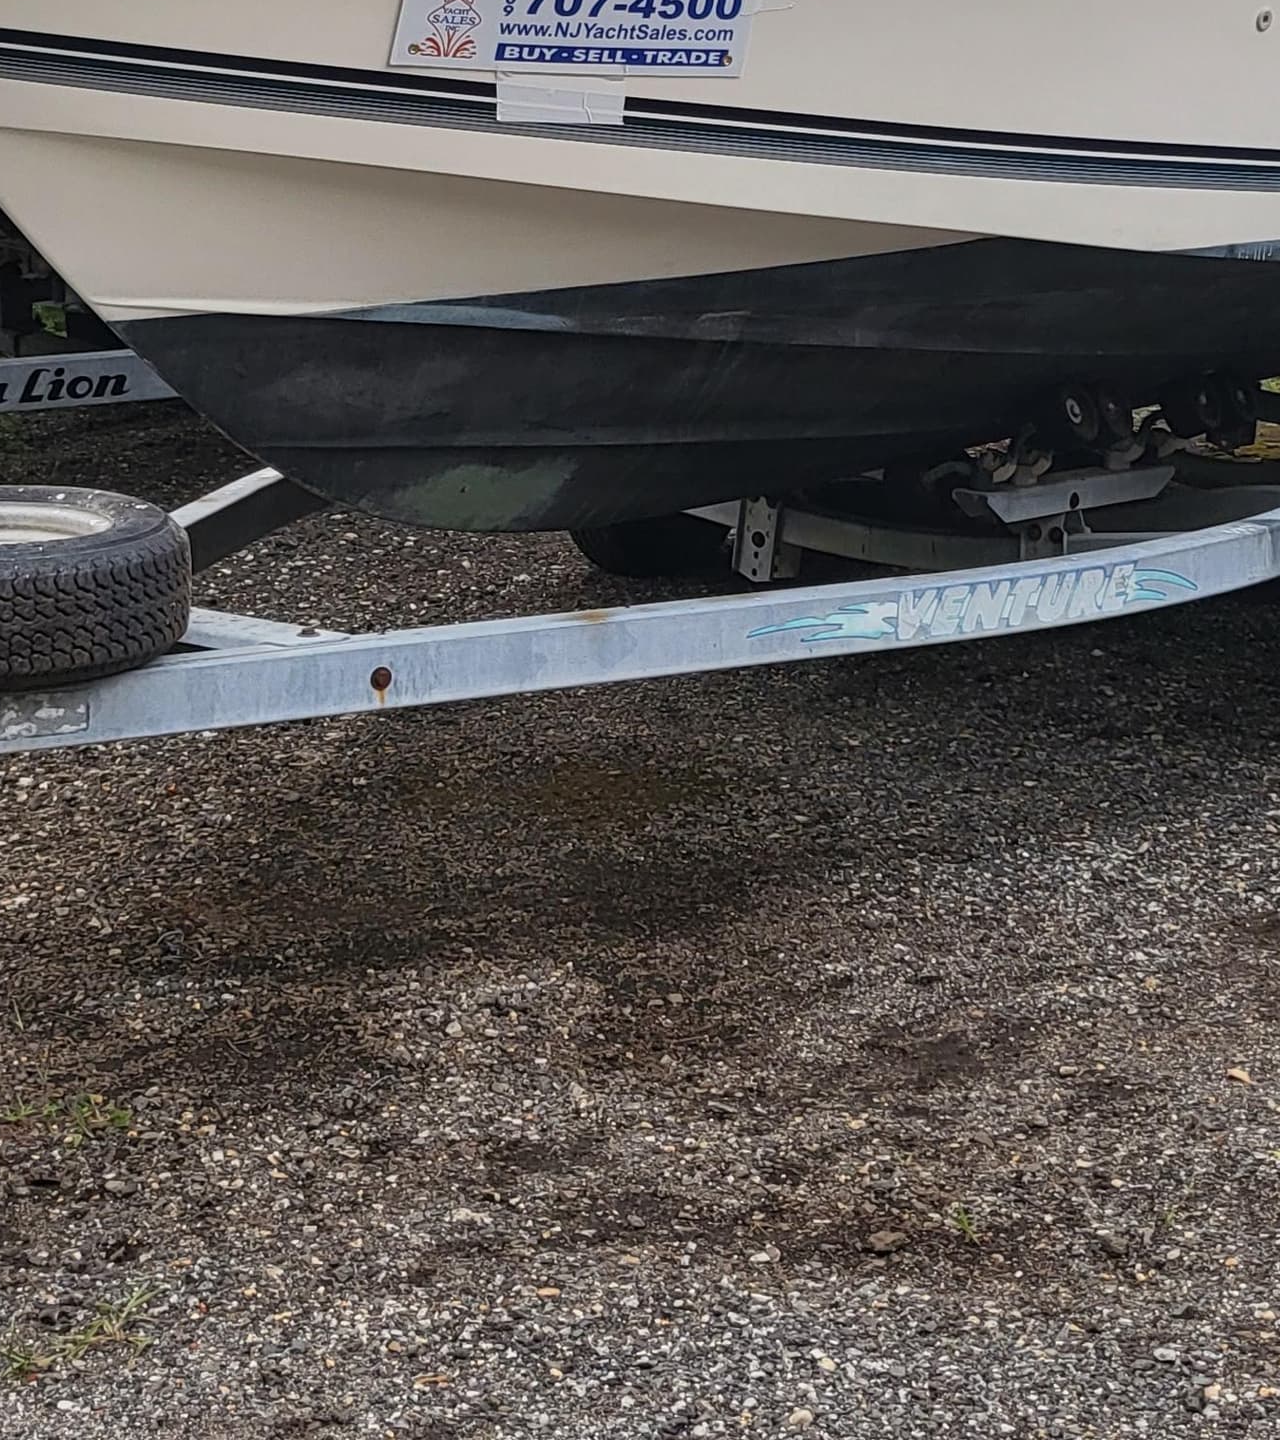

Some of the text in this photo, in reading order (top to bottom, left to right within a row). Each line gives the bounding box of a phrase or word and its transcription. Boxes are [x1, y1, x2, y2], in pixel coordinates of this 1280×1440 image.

[431, 14, 477, 26] SALES
[442, 6, 471, 15] YACHT
[499, 21, 734, 42] www.NJYachtSales.com
[503, 47, 722, 66] BUY SELL TRADE
[18, 367, 131, 404] Lion
[895, 560, 1138, 640] VENTURE
